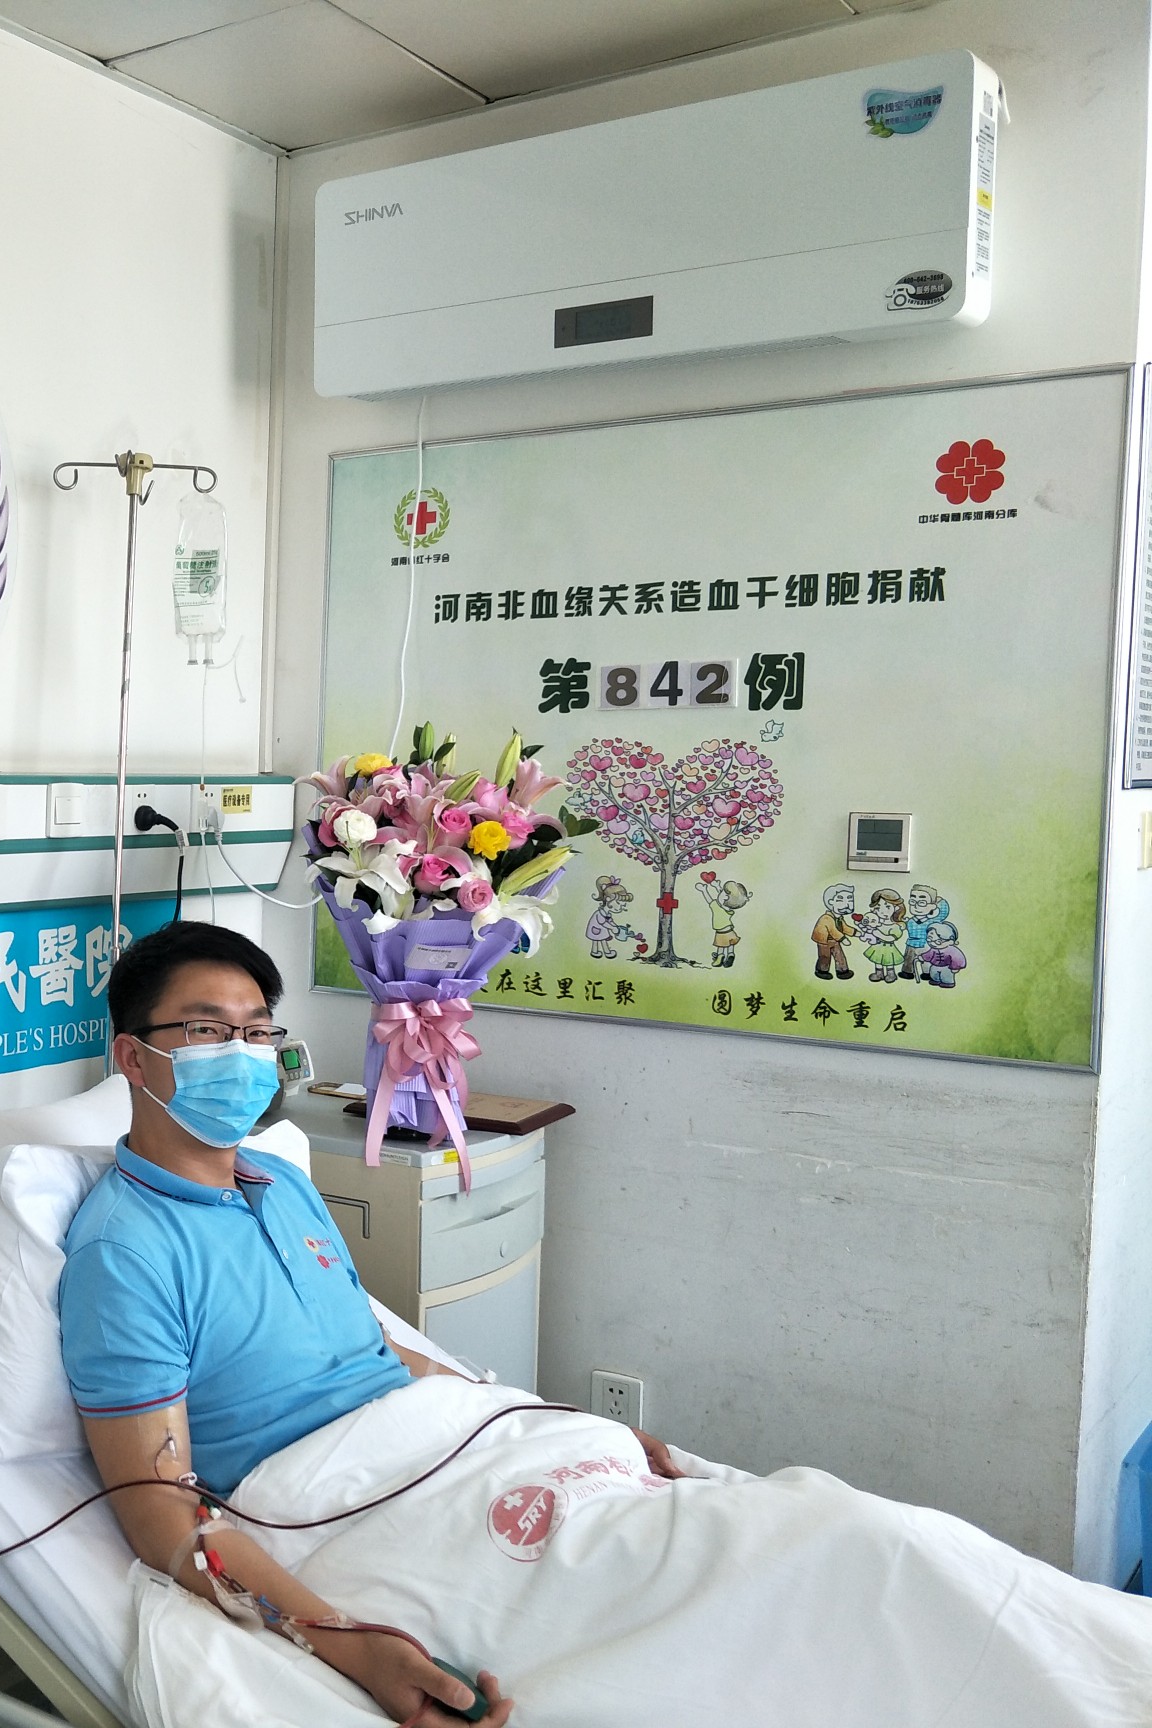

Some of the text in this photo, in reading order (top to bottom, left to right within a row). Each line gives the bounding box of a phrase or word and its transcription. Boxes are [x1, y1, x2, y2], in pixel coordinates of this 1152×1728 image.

[344, 202, 404, 226] SHINVA
[918, 508, 1018, 525] 中华骨髓库河南分库
[434, 566, 946, 624] 河南非血缘关系造血干细胞捐献
[477, 968, 908, 1033] 在这里汇聚 圆梦生命重启
[49, 1017, 107, 1049] HOSPI
